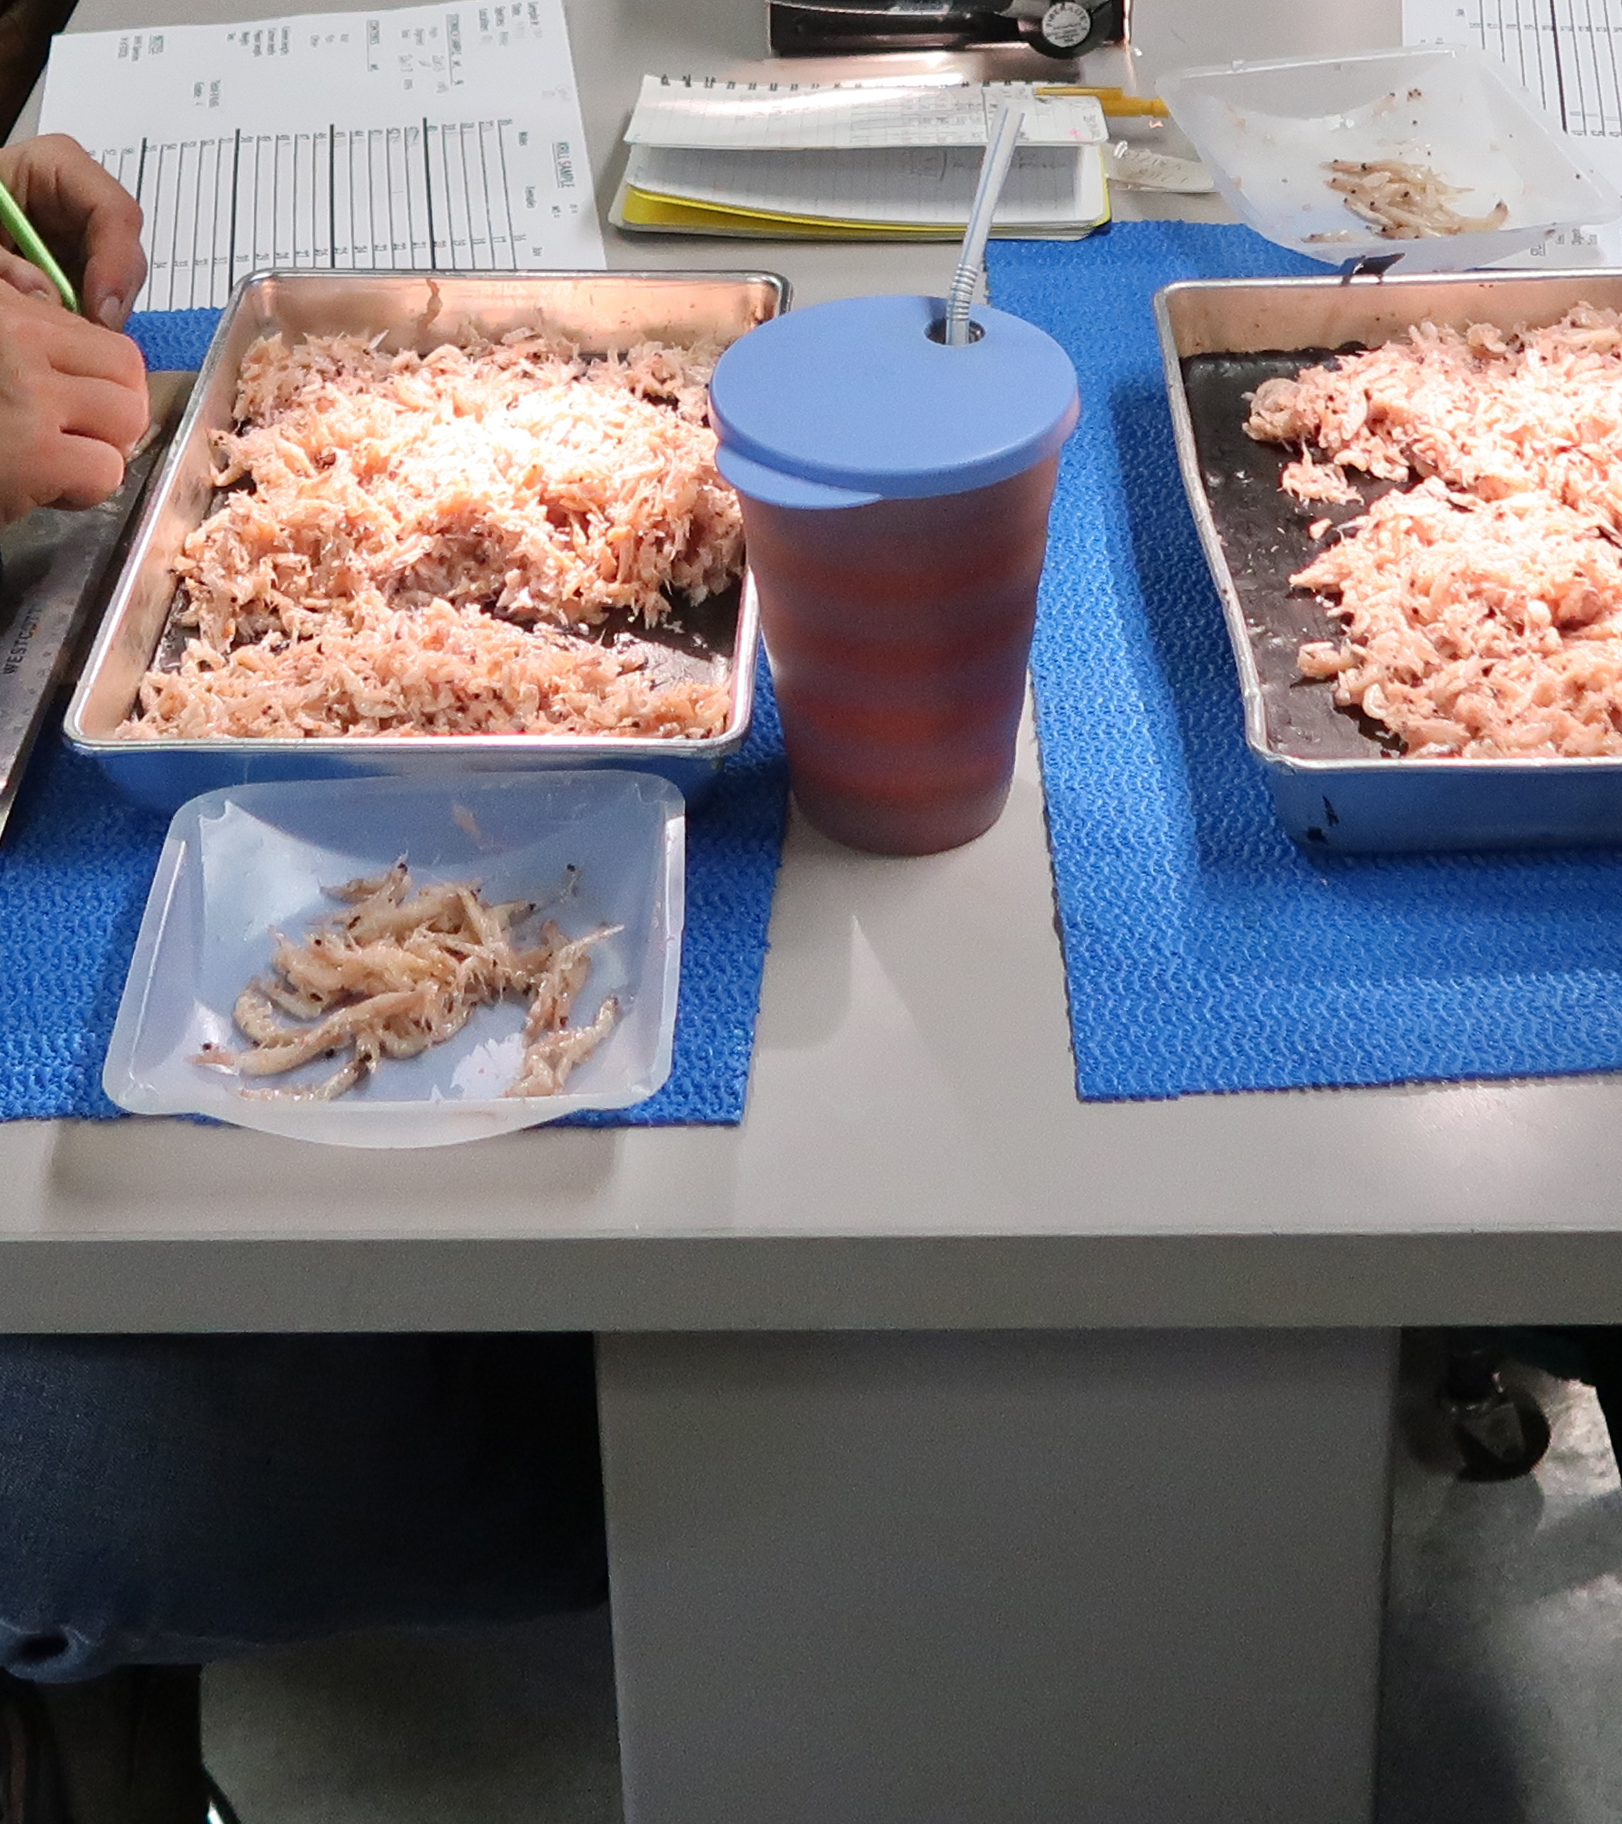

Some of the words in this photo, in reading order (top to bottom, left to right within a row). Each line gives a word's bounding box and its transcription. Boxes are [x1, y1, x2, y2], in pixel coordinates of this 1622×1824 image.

[556, 141, 571, 160] KRILL
[558, 161, 575, 189] SAMPLE
[1, 604, 43, 676] WESTCOTT
